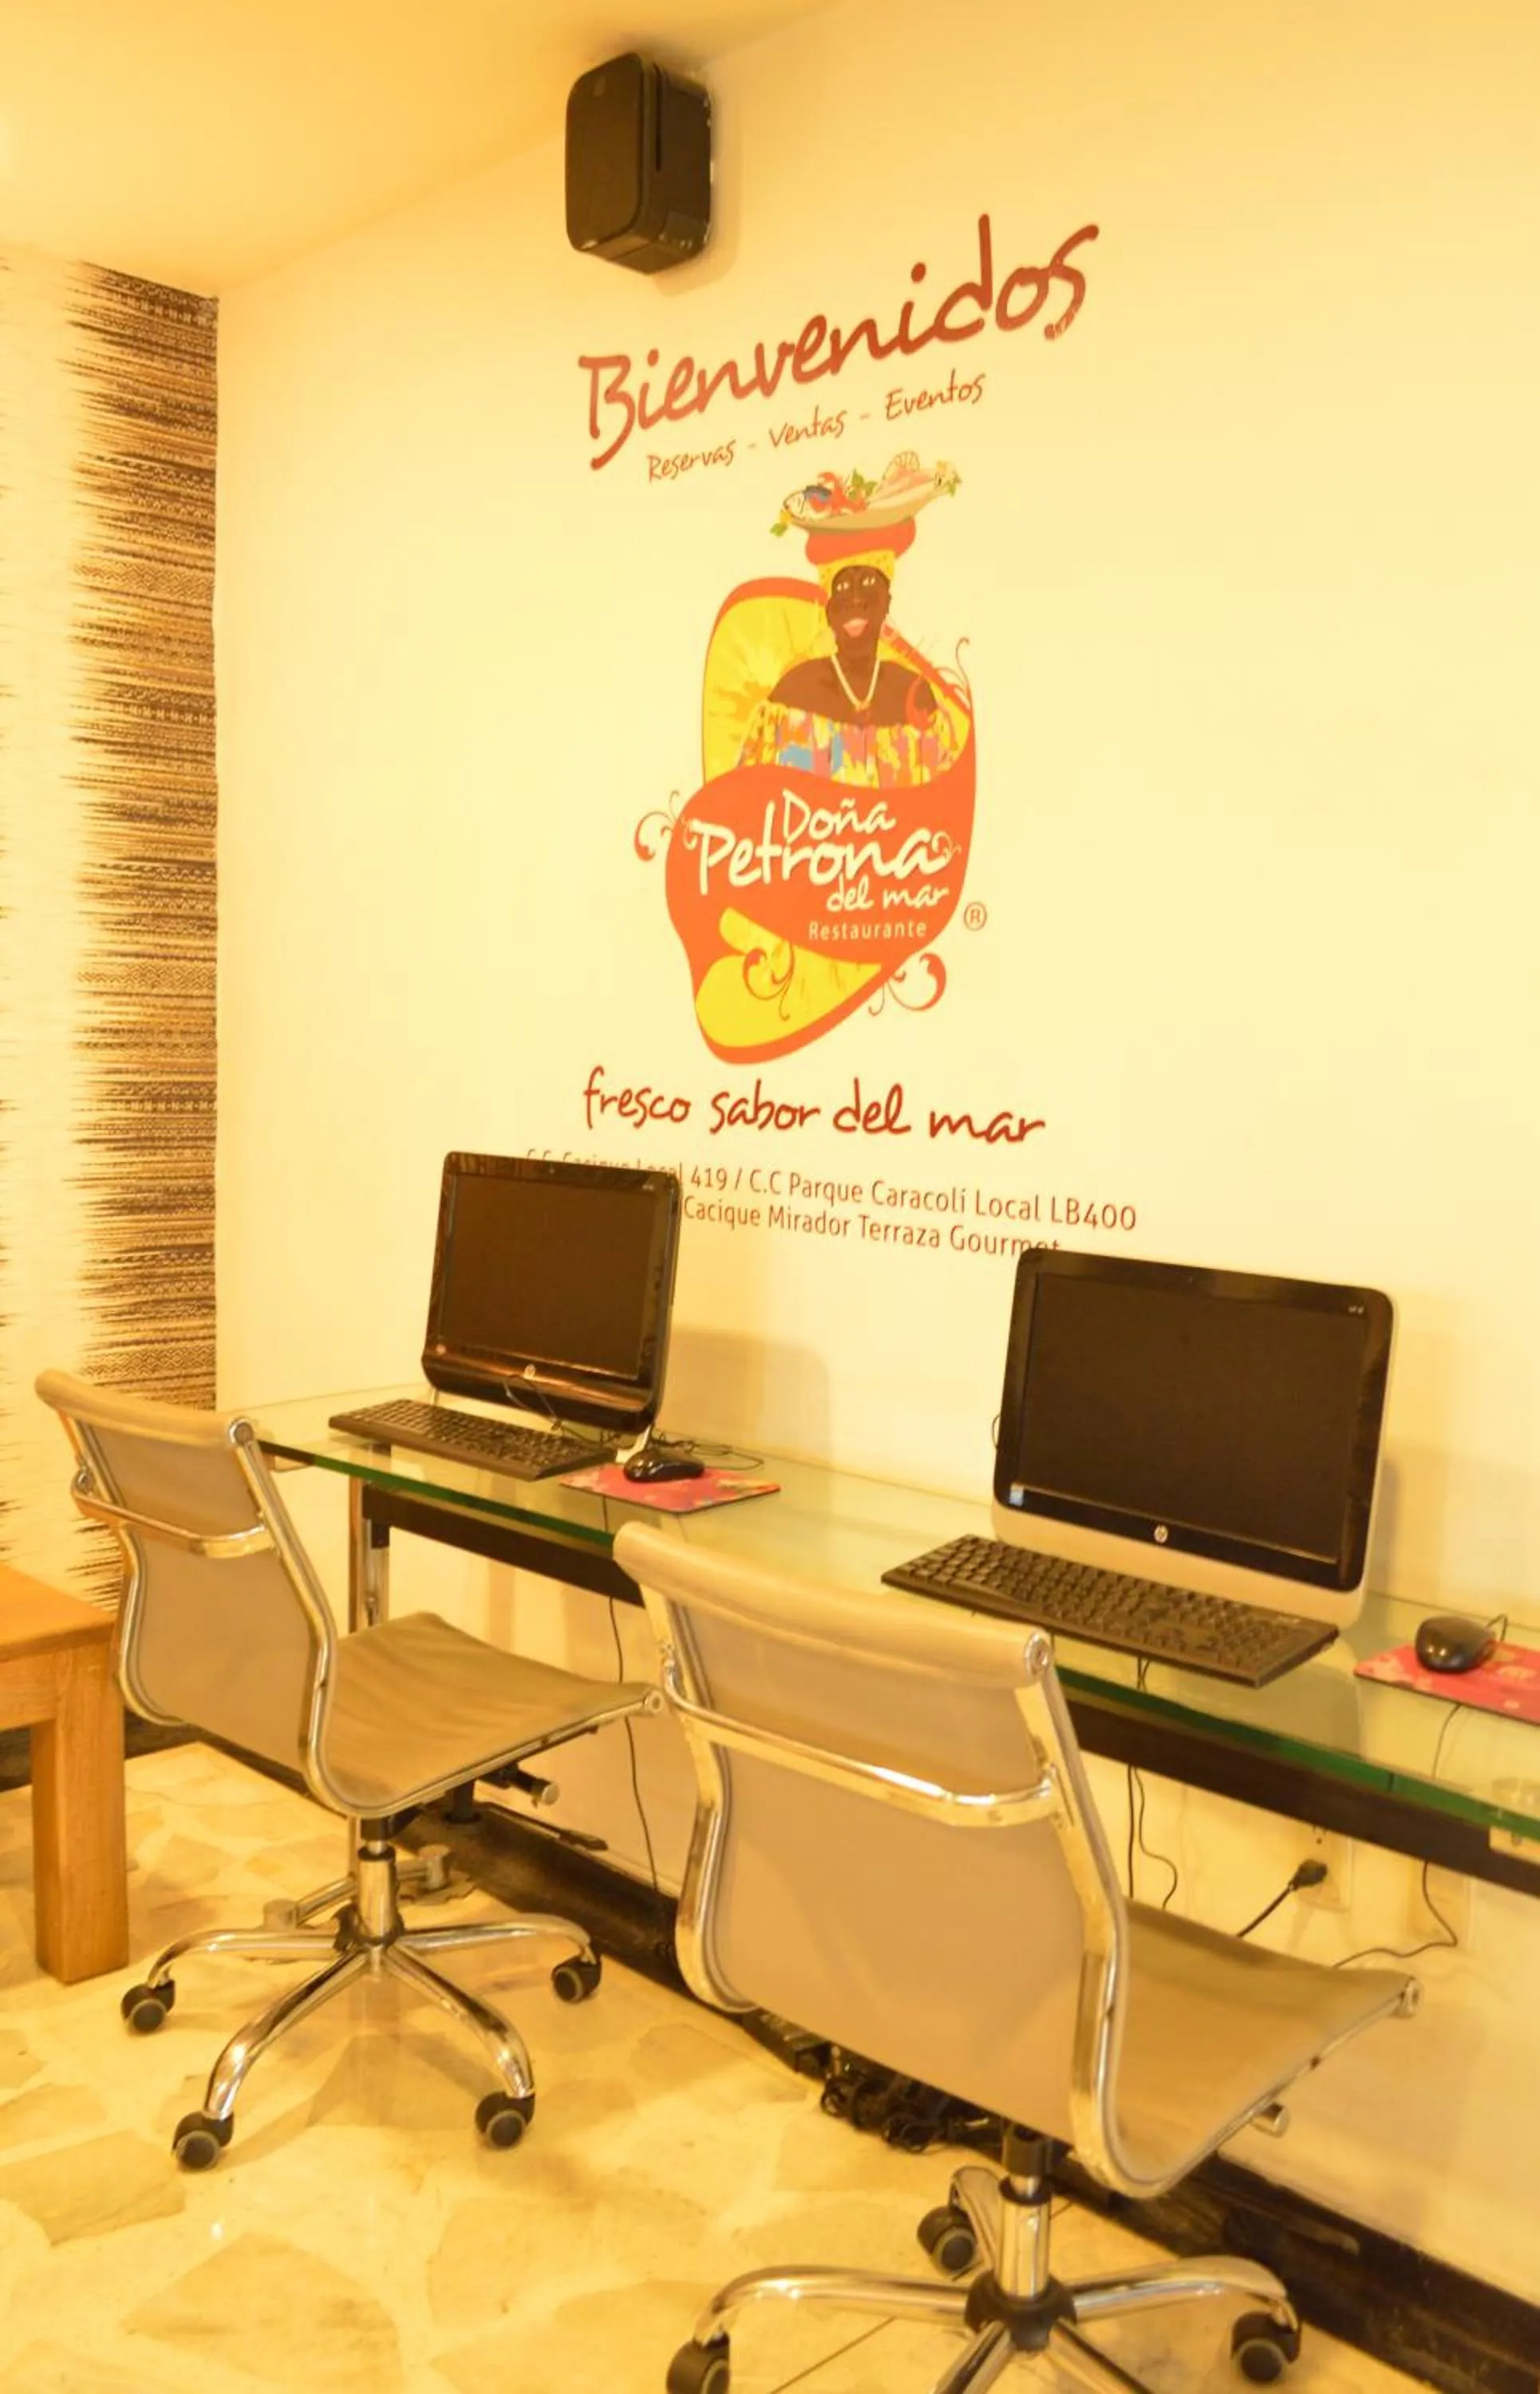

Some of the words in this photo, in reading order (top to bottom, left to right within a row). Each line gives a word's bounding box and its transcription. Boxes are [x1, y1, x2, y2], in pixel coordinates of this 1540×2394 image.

[578, 214, 1100, 472] Bienvenidos
[647, 440, 736, 484] Reservas
[885, 368, 986, 421] Eventos
[688, 800, 951, 895] Petrona
[782, 788, 896, 840] Doña
[826, 873, 875, 912] del
[882, 883, 950, 910] mar
[808, 919, 927, 941] Restaurante
[583, 1065, 692, 1130] fresco
[709, 1078, 821, 1135] sabor
[832, 1077, 912, 1136] del
[929, 1110, 1047, 1146] mar
[684, 1195, 761, 1230] Cacique
[768, 1203, 851, 1238] Mirador
[858, 1213, 941, 1249] Terraza
[689, 1165, 729, 1191] 419
[749, 1168, 782, 1195] C.C
[789, 1171, 864, 1208] Parque
[975, 1189, 1041, 1223] Local
[1051, 1195, 1137, 1232] LB400
